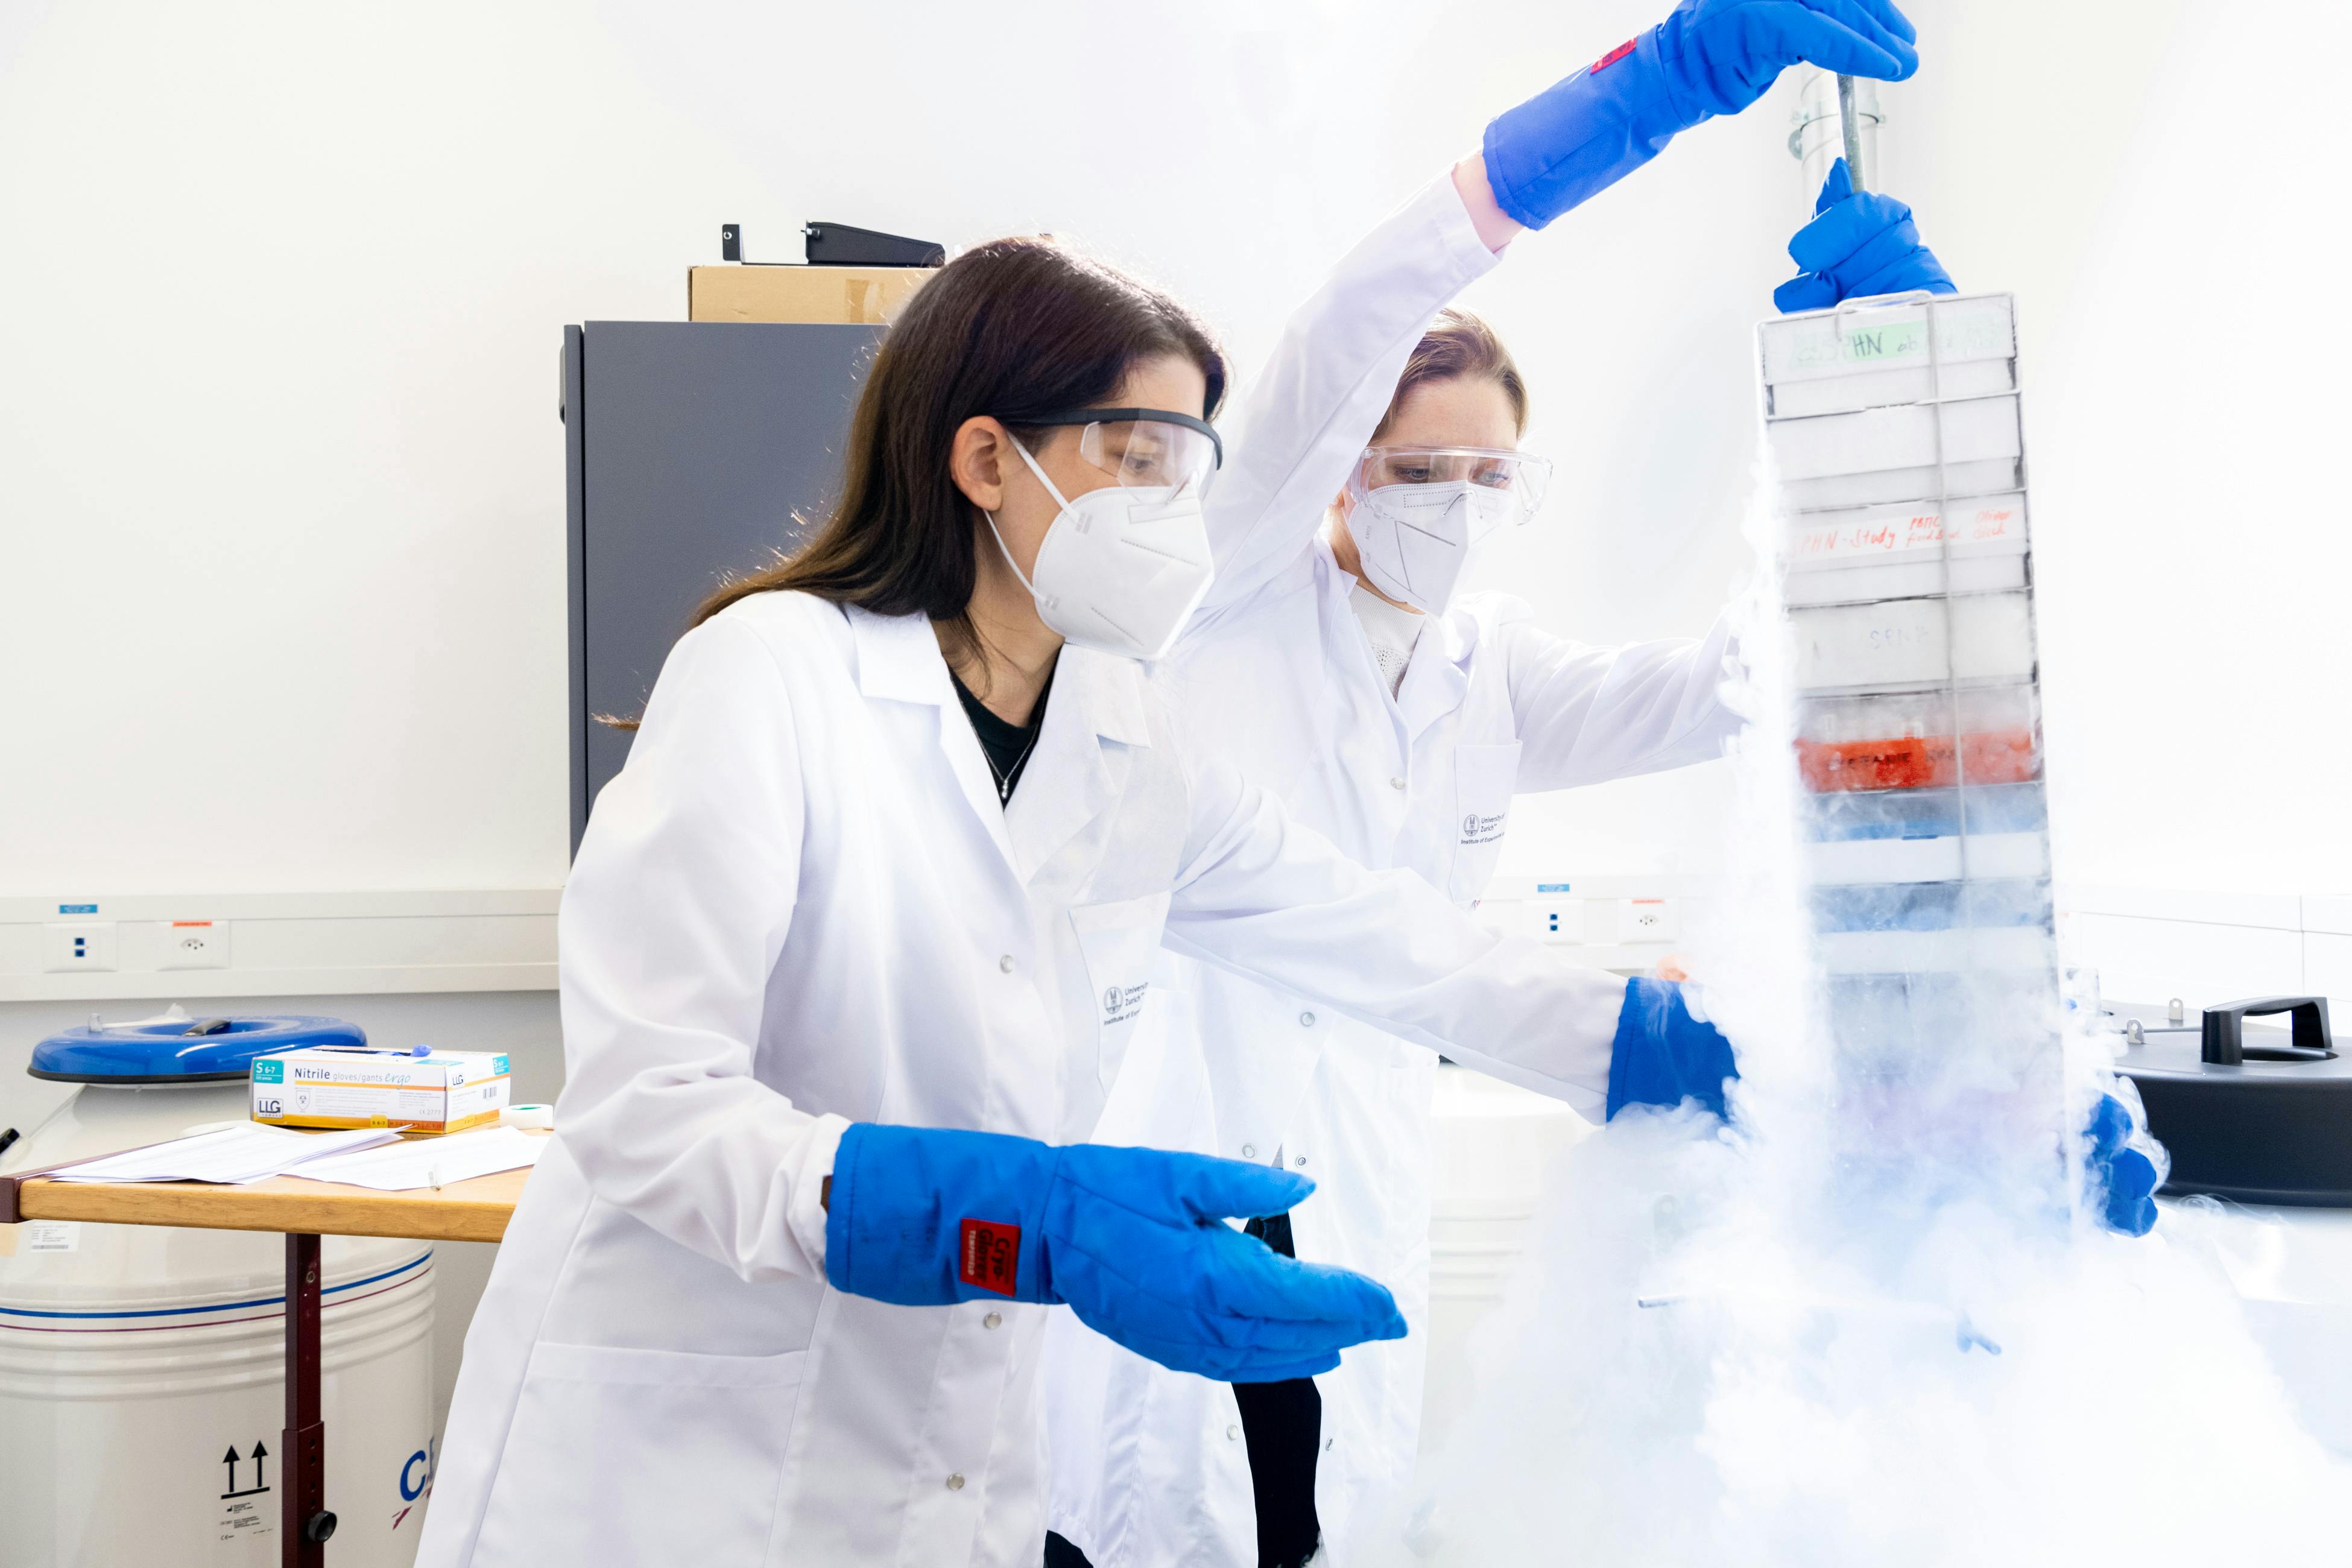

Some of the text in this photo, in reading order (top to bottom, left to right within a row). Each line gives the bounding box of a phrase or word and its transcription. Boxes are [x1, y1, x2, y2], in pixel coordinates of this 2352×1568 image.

[1481, 815, 1501, 824] University
[256, 1062, 263, 1073] S
[295, 1068, 411, 1090] Nitrile gloves/gants ergo
[452, 1075, 464, 1086] LLG
[259, 1100, 281, 1114] LLG
